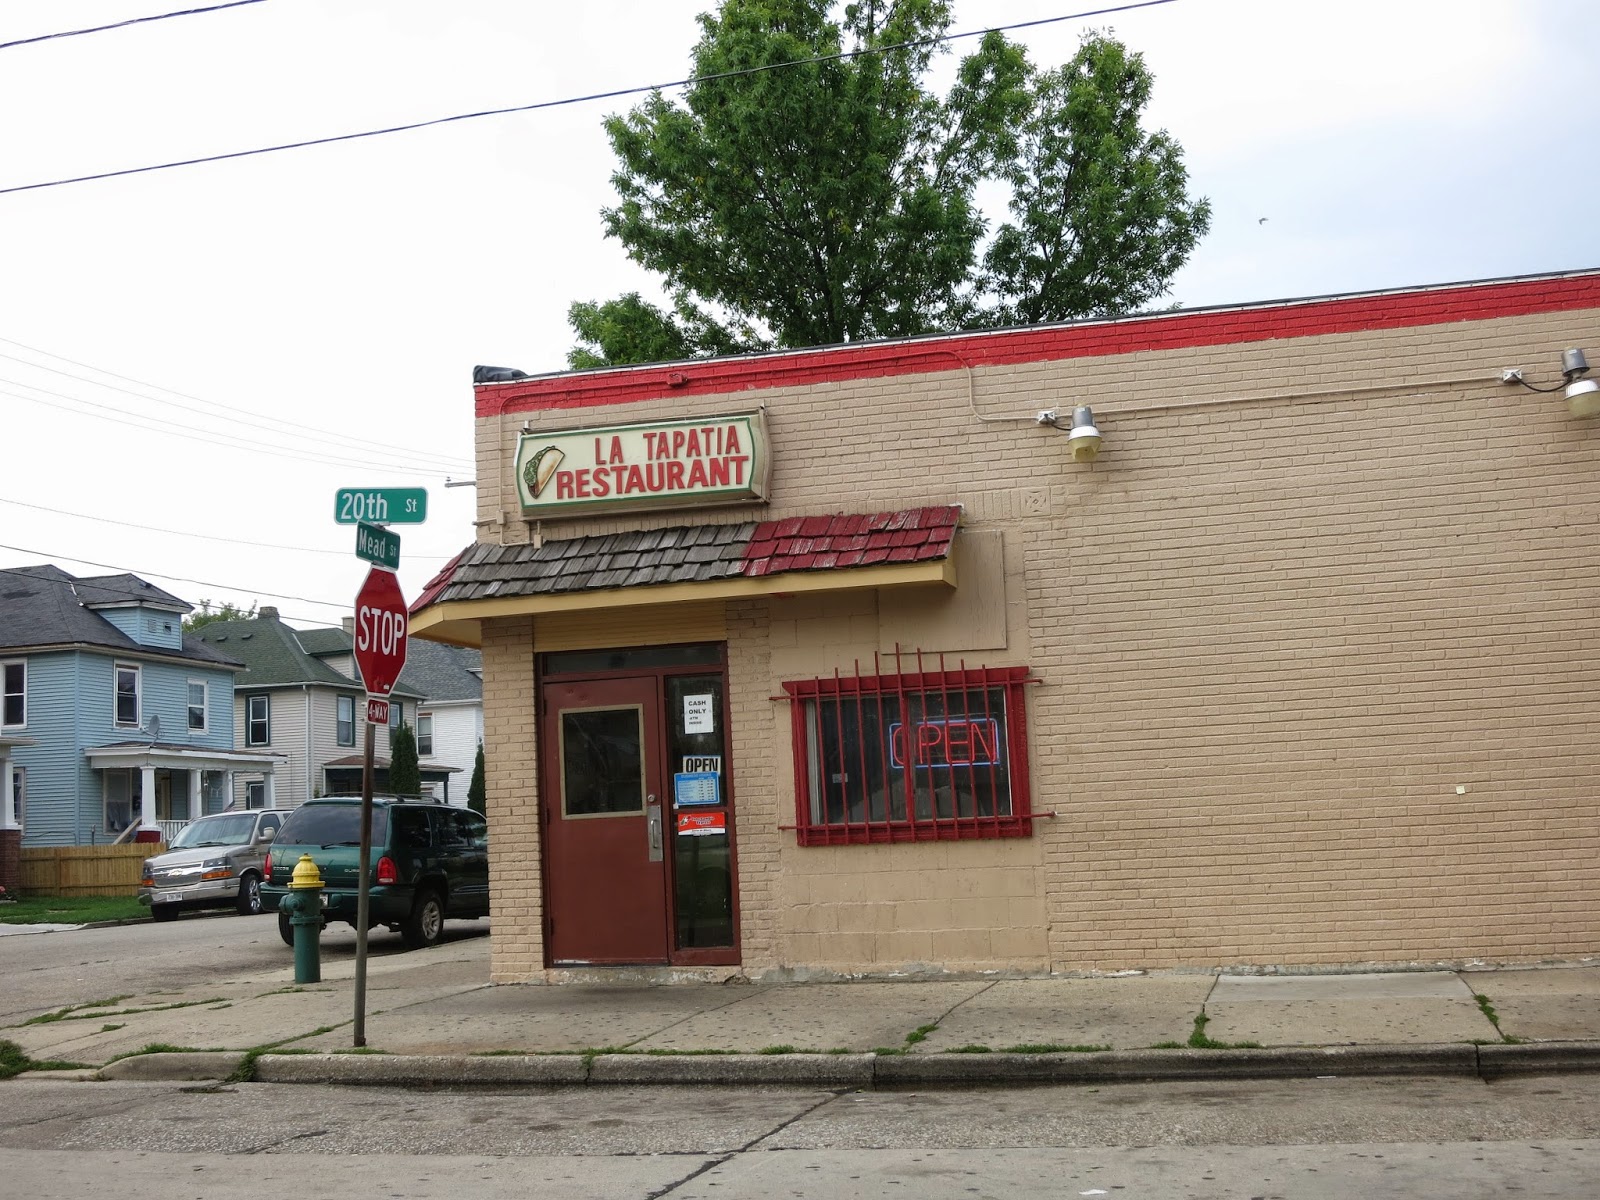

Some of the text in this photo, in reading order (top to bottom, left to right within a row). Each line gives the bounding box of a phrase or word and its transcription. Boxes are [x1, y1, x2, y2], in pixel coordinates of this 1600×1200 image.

[594, 425, 741, 465] LA TAPATIA
[556, 455, 749, 500] RESTAURANT
[340, 492, 418, 520] 20th St
[358, 528, 397, 559] Mead St
[358, 605, 405, 656] STOP
[368, 703, 388, 720] 4-WAY
[892, 722, 996, 765] OPEN
[685, 757, 719, 773] OPEN
